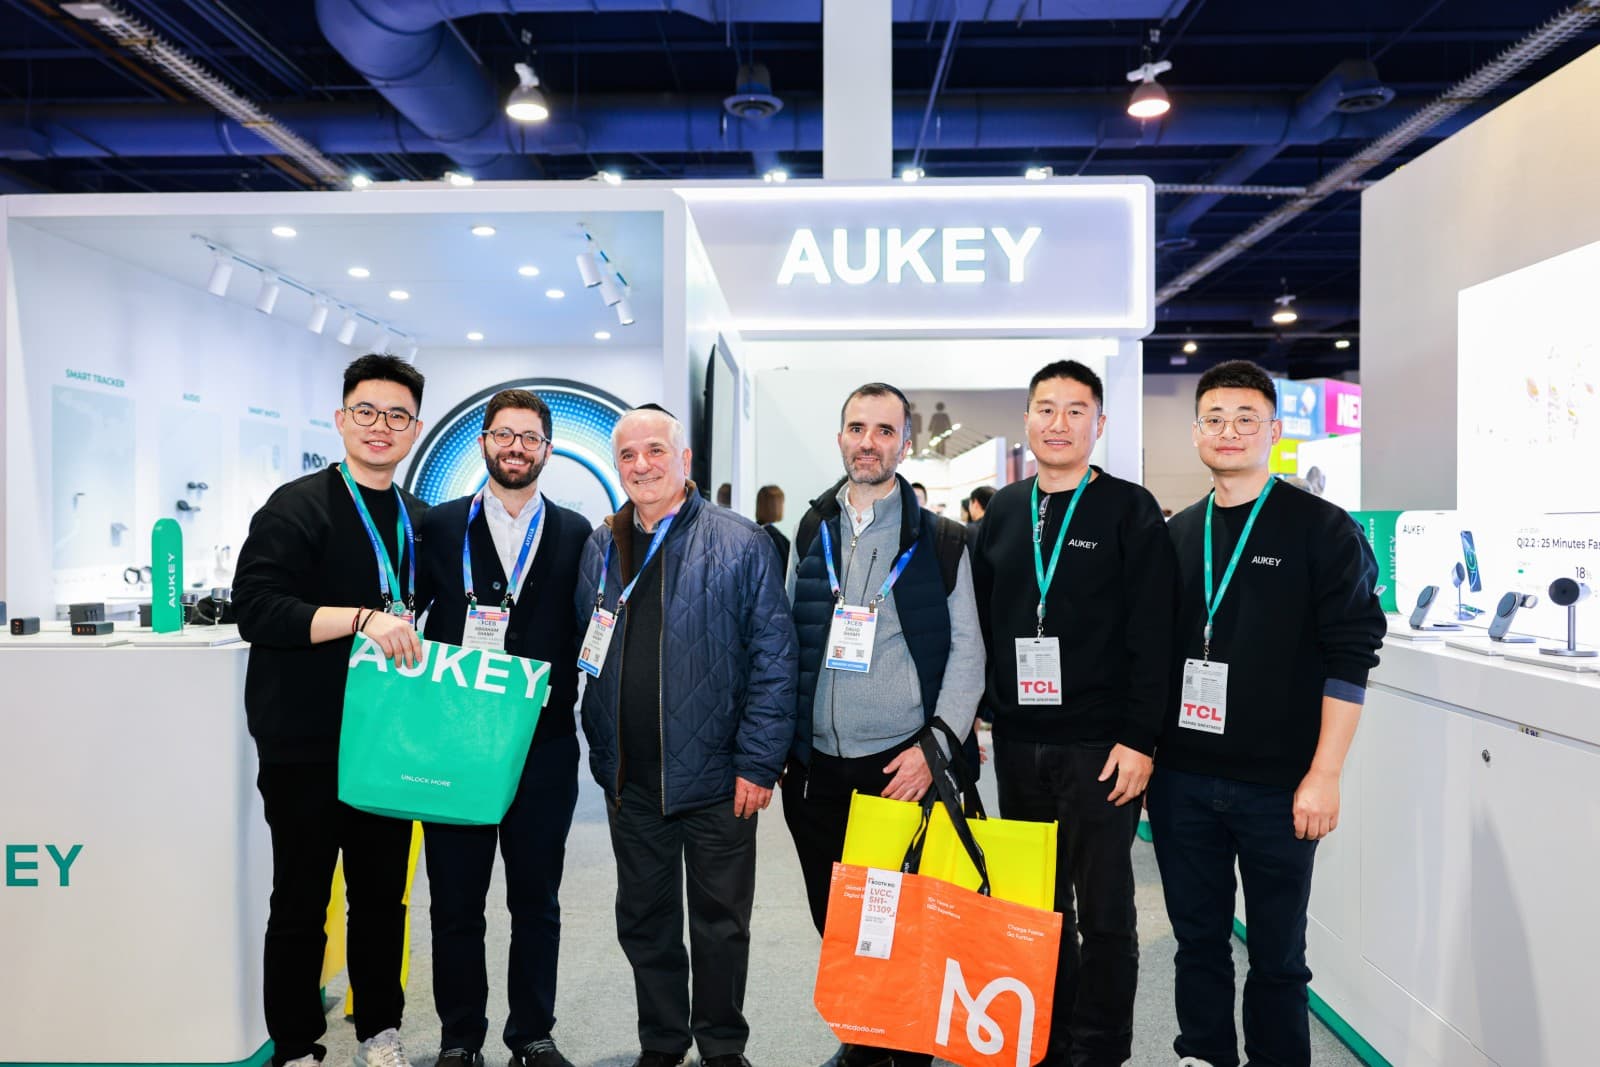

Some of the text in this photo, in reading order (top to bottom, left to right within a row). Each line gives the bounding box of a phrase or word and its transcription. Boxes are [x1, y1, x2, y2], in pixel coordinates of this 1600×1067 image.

[777, 227, 1042, 285] AUKEY
[65, 368, 126, 388] SMART TRACKER
[1336, 393, 1360, 428] NE
[1068, 538, 1098, 550] AUKEY
[1541, 538, 1551, 548] 25
[1552, 537, 1586, 549] Minutes
[1251, 555, 1282, 567] AUKEY
[168, 551, 177, 609] AUKEY
[349, 630, 552, 699] AUKEY
[1020, 681, 1059, 694] TCL
[1183, 703, 1222, 722] TCL
[400, 773, 452, 788] UNLOCK MORE
[6, 844, 84, 887] EY
